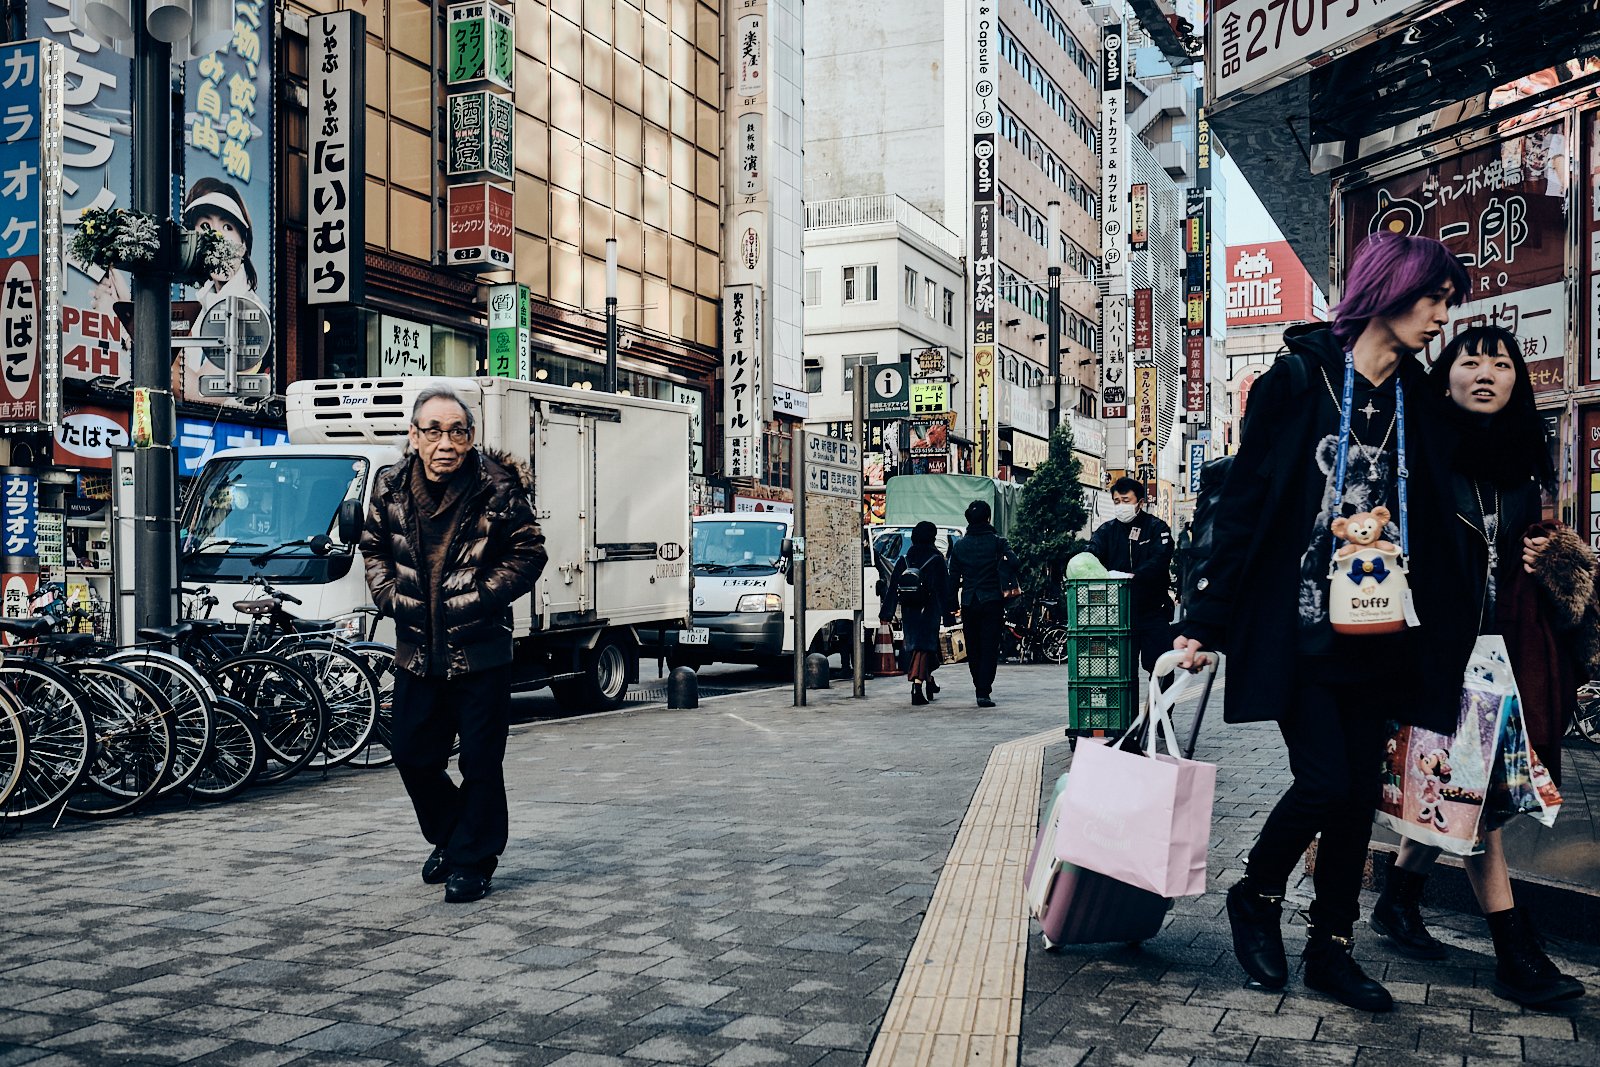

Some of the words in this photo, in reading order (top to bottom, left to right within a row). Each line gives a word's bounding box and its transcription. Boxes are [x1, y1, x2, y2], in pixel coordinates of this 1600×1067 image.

[455, 29, 467, 79] クォーク
[978, 21, 989, 74] Capsule
[1104, 33, 1121, 81] Booth
[1221, 11, 1241, 79] 全品
[1108, 97, 1118, 154] ネットカフェ
[1, 49, 37, 255] カラオケ
[974, 139, 994, 193] Booth
[1108, 174, 1118, 213] カプセル
[312, 139, 347, 294] にいむら
[451, 220, 485, 234] ビックワン
[974, 255, 994, 313] 甘太郎
[1226, 278, 1281, 308] GAME
[6, 278, 33, 382] たばこ
[976, 321, 993, 332] 4F
[976, 333, 993, 343] 3F
[385, 347, 428, 372] ルノアール
[0, 401, 37, 418] 直売所
[342, 396, 368, 405] Topre
[730, 350, 749, 428] ルノアール
[915, 393, 943, 402] ロード
[1140, 371, 1151, 425] きんくら酒場
[1106, 408, 1121, 417] B1
[61, 422, 121, 448] たばこ
[810, 438, 819, 450] JR
[821, 440, 837, 454] 新宿駅
[6, 477, 29, 554] カラオケ
[1351, 597, 1389, 609] Duffy
